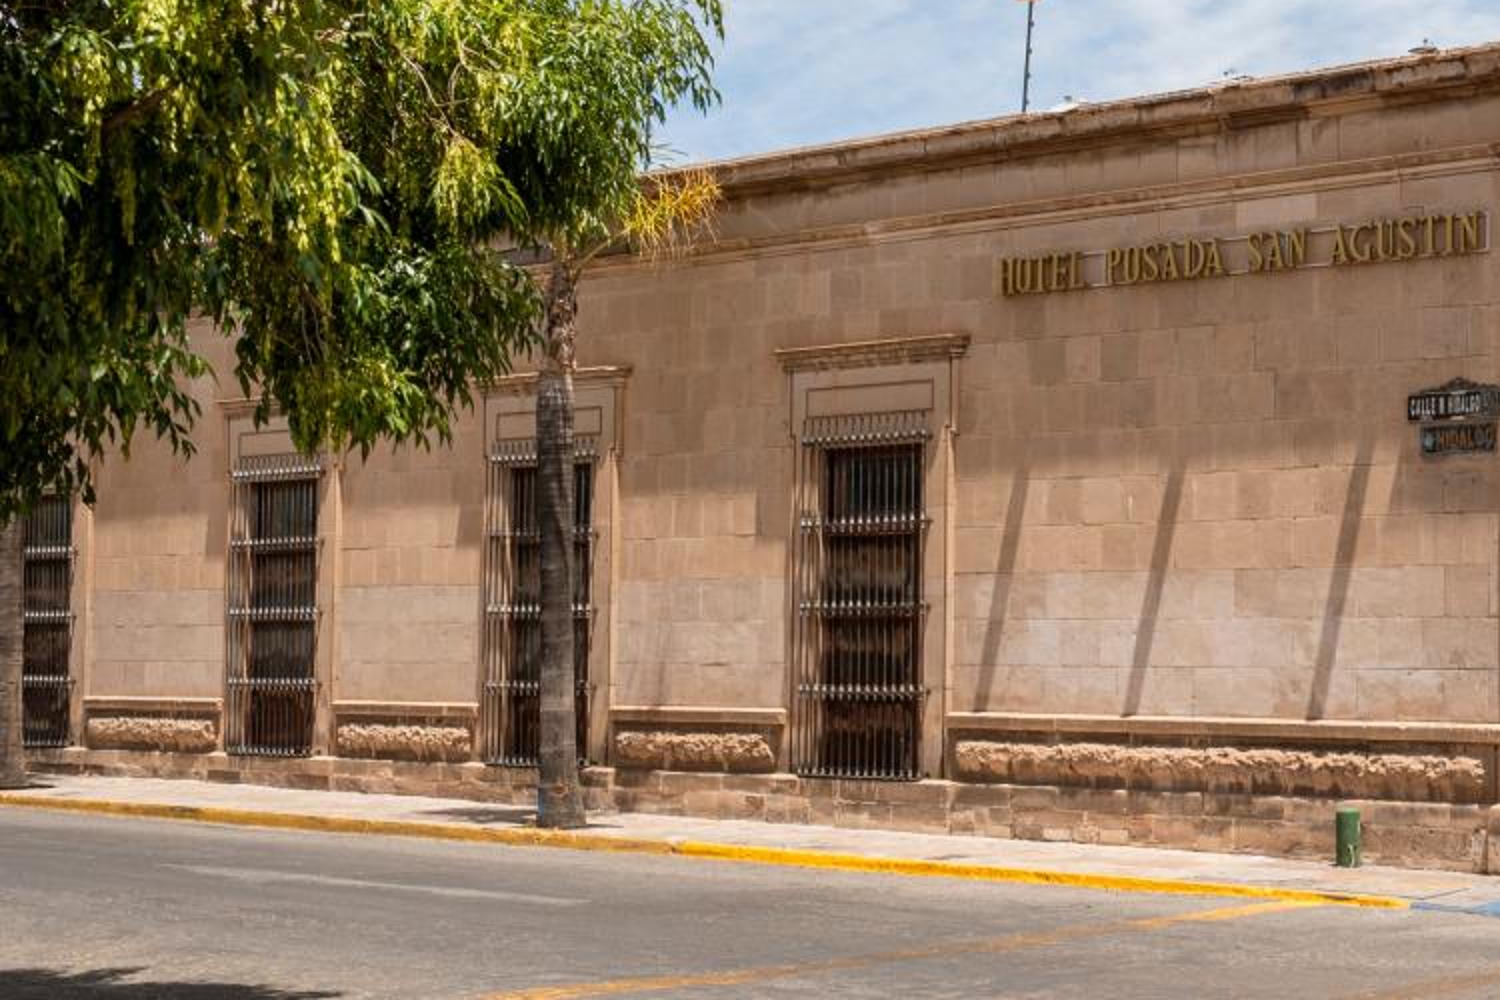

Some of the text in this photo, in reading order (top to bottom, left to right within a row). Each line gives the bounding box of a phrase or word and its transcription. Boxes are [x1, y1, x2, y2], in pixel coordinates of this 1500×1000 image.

[1104, 235, 1224, 285] POSADA
[1247, 225, 1306, 272] SAN
[1332, 211, 1479, 264] AGUSTIN
